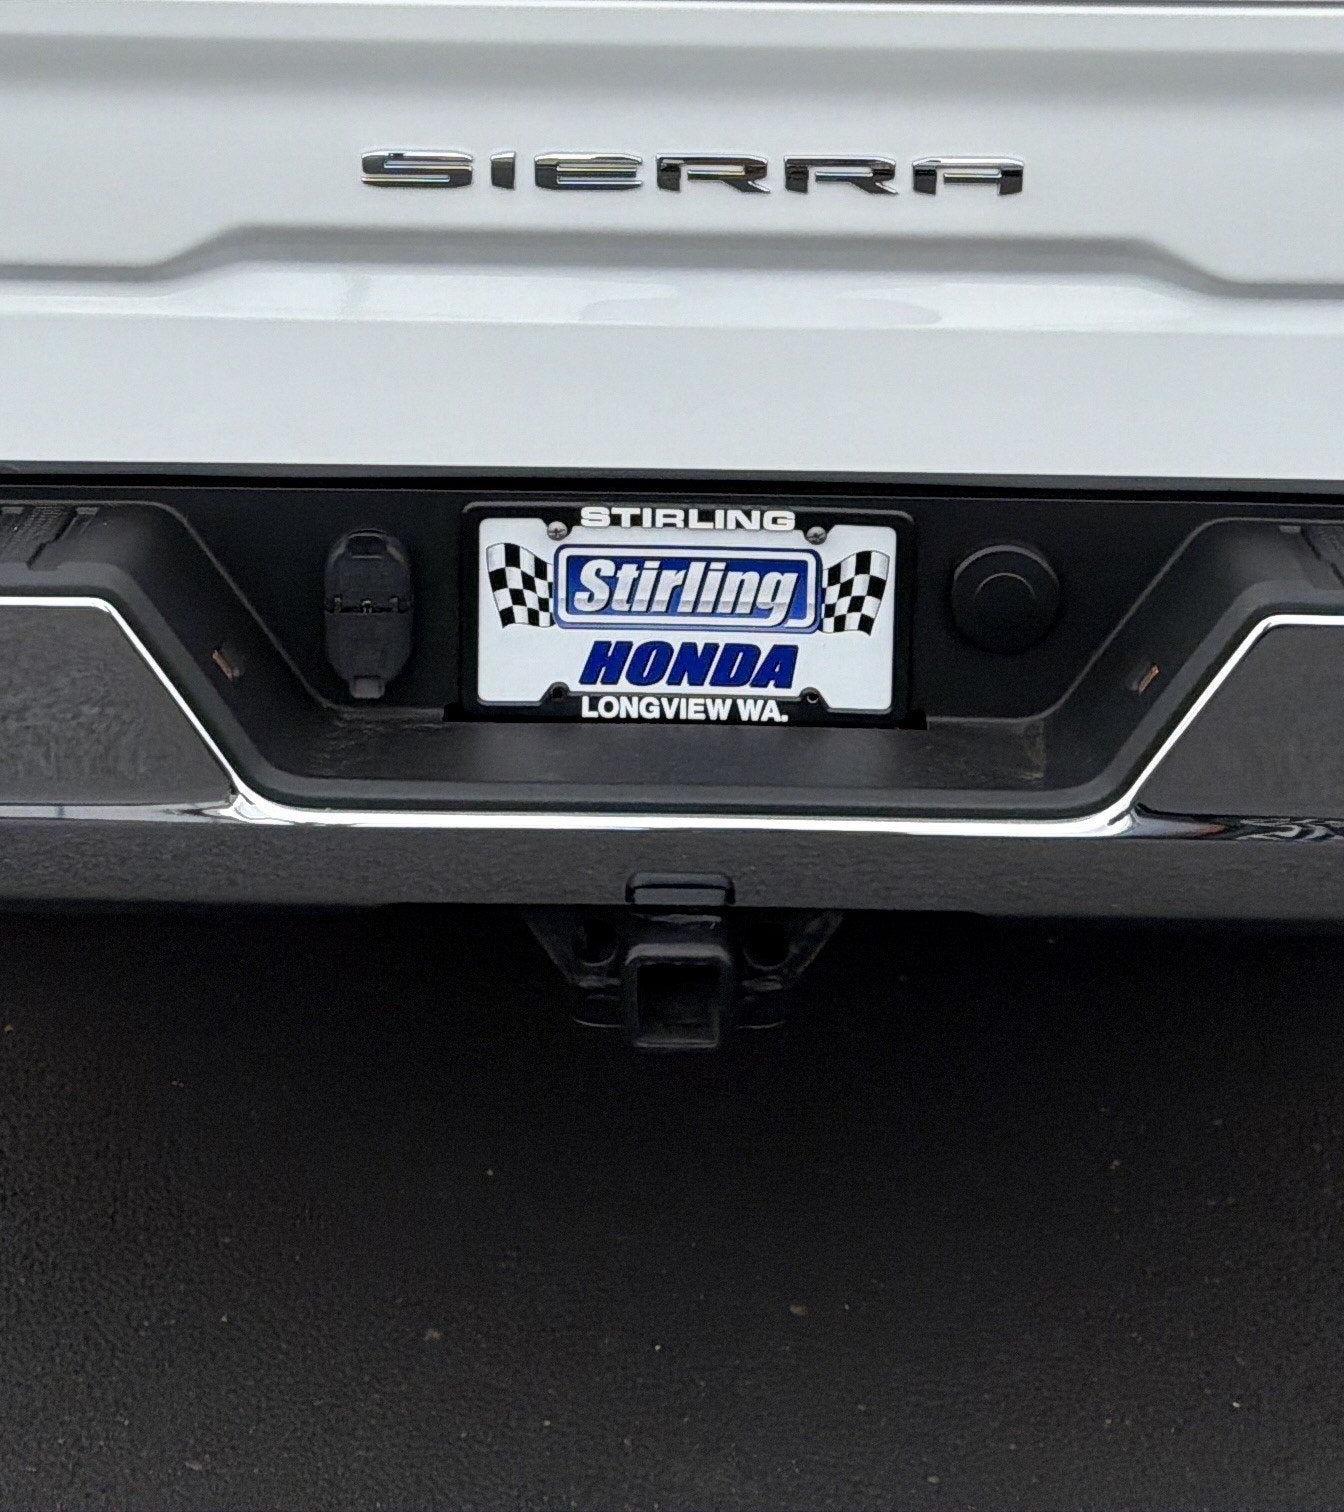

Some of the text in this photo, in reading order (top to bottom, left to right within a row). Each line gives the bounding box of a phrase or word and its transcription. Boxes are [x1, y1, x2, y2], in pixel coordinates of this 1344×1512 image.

[360, 150, 1025, 196] SIERRA
[580, 507, 796, 531] STIRLING
[572, 559, 799, 627] Stirling
[578, 640, 799, 689] HONDA
[581, 696, 789, 723] LONGVIEW WA.
